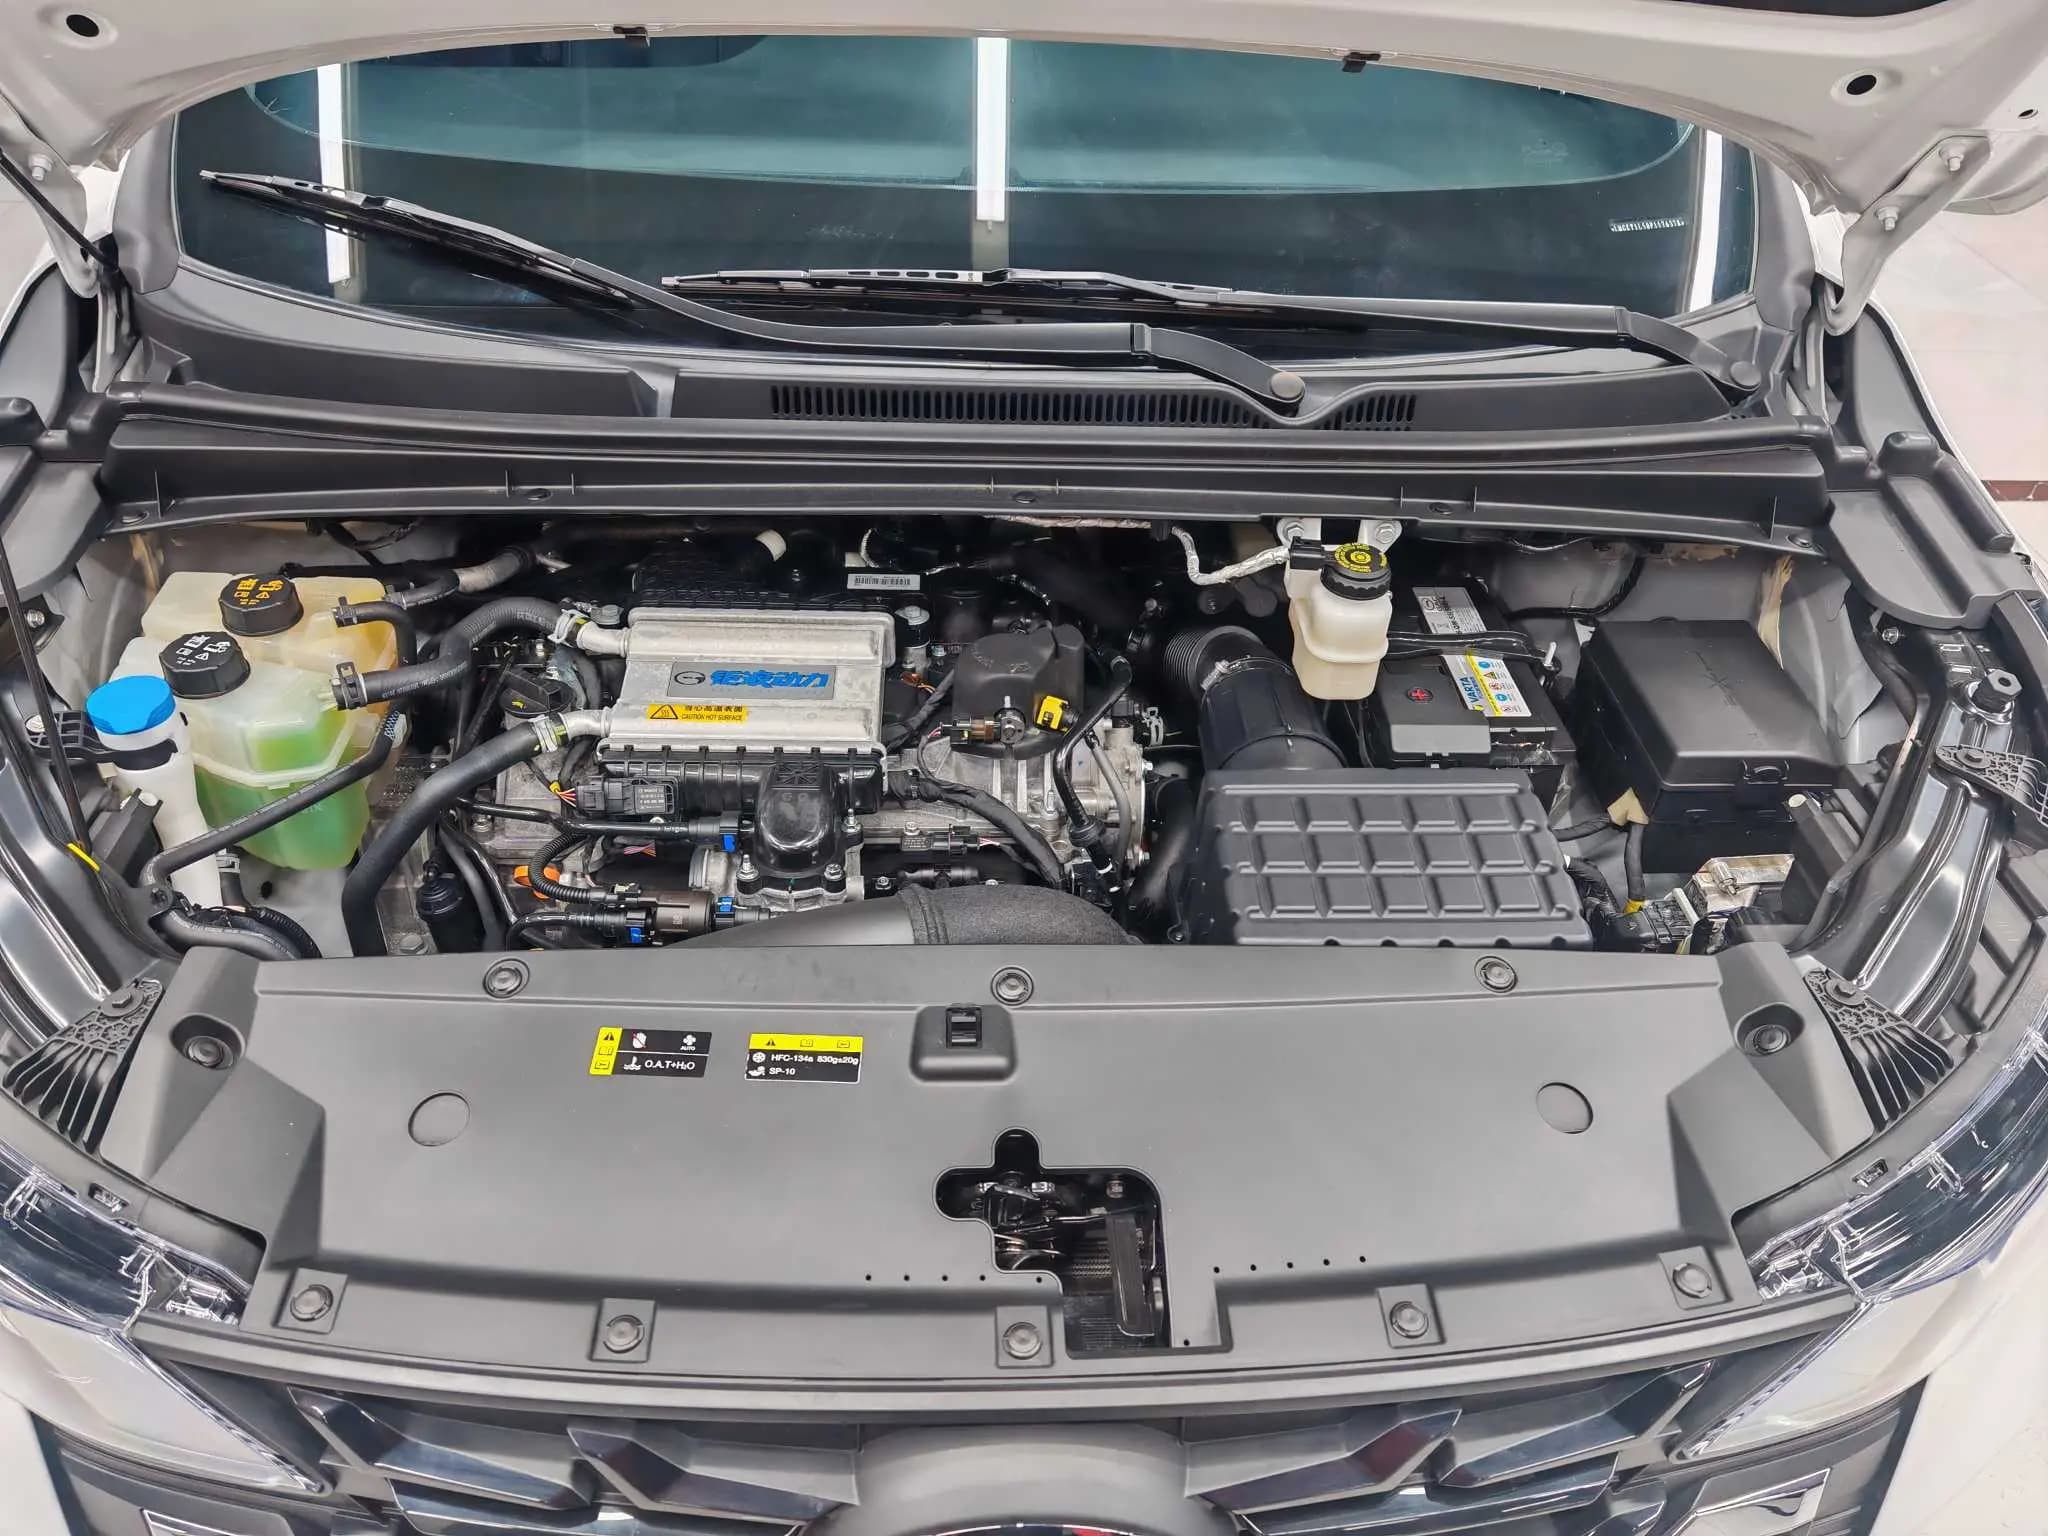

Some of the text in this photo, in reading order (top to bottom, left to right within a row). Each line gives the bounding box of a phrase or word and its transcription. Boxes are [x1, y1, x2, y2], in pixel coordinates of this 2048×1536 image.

[1460, 676, 1480, 703] VARTA
[771, 1053, 814, 1063] HFC-134a
[768, 1067, 796, 1076] SP-10
